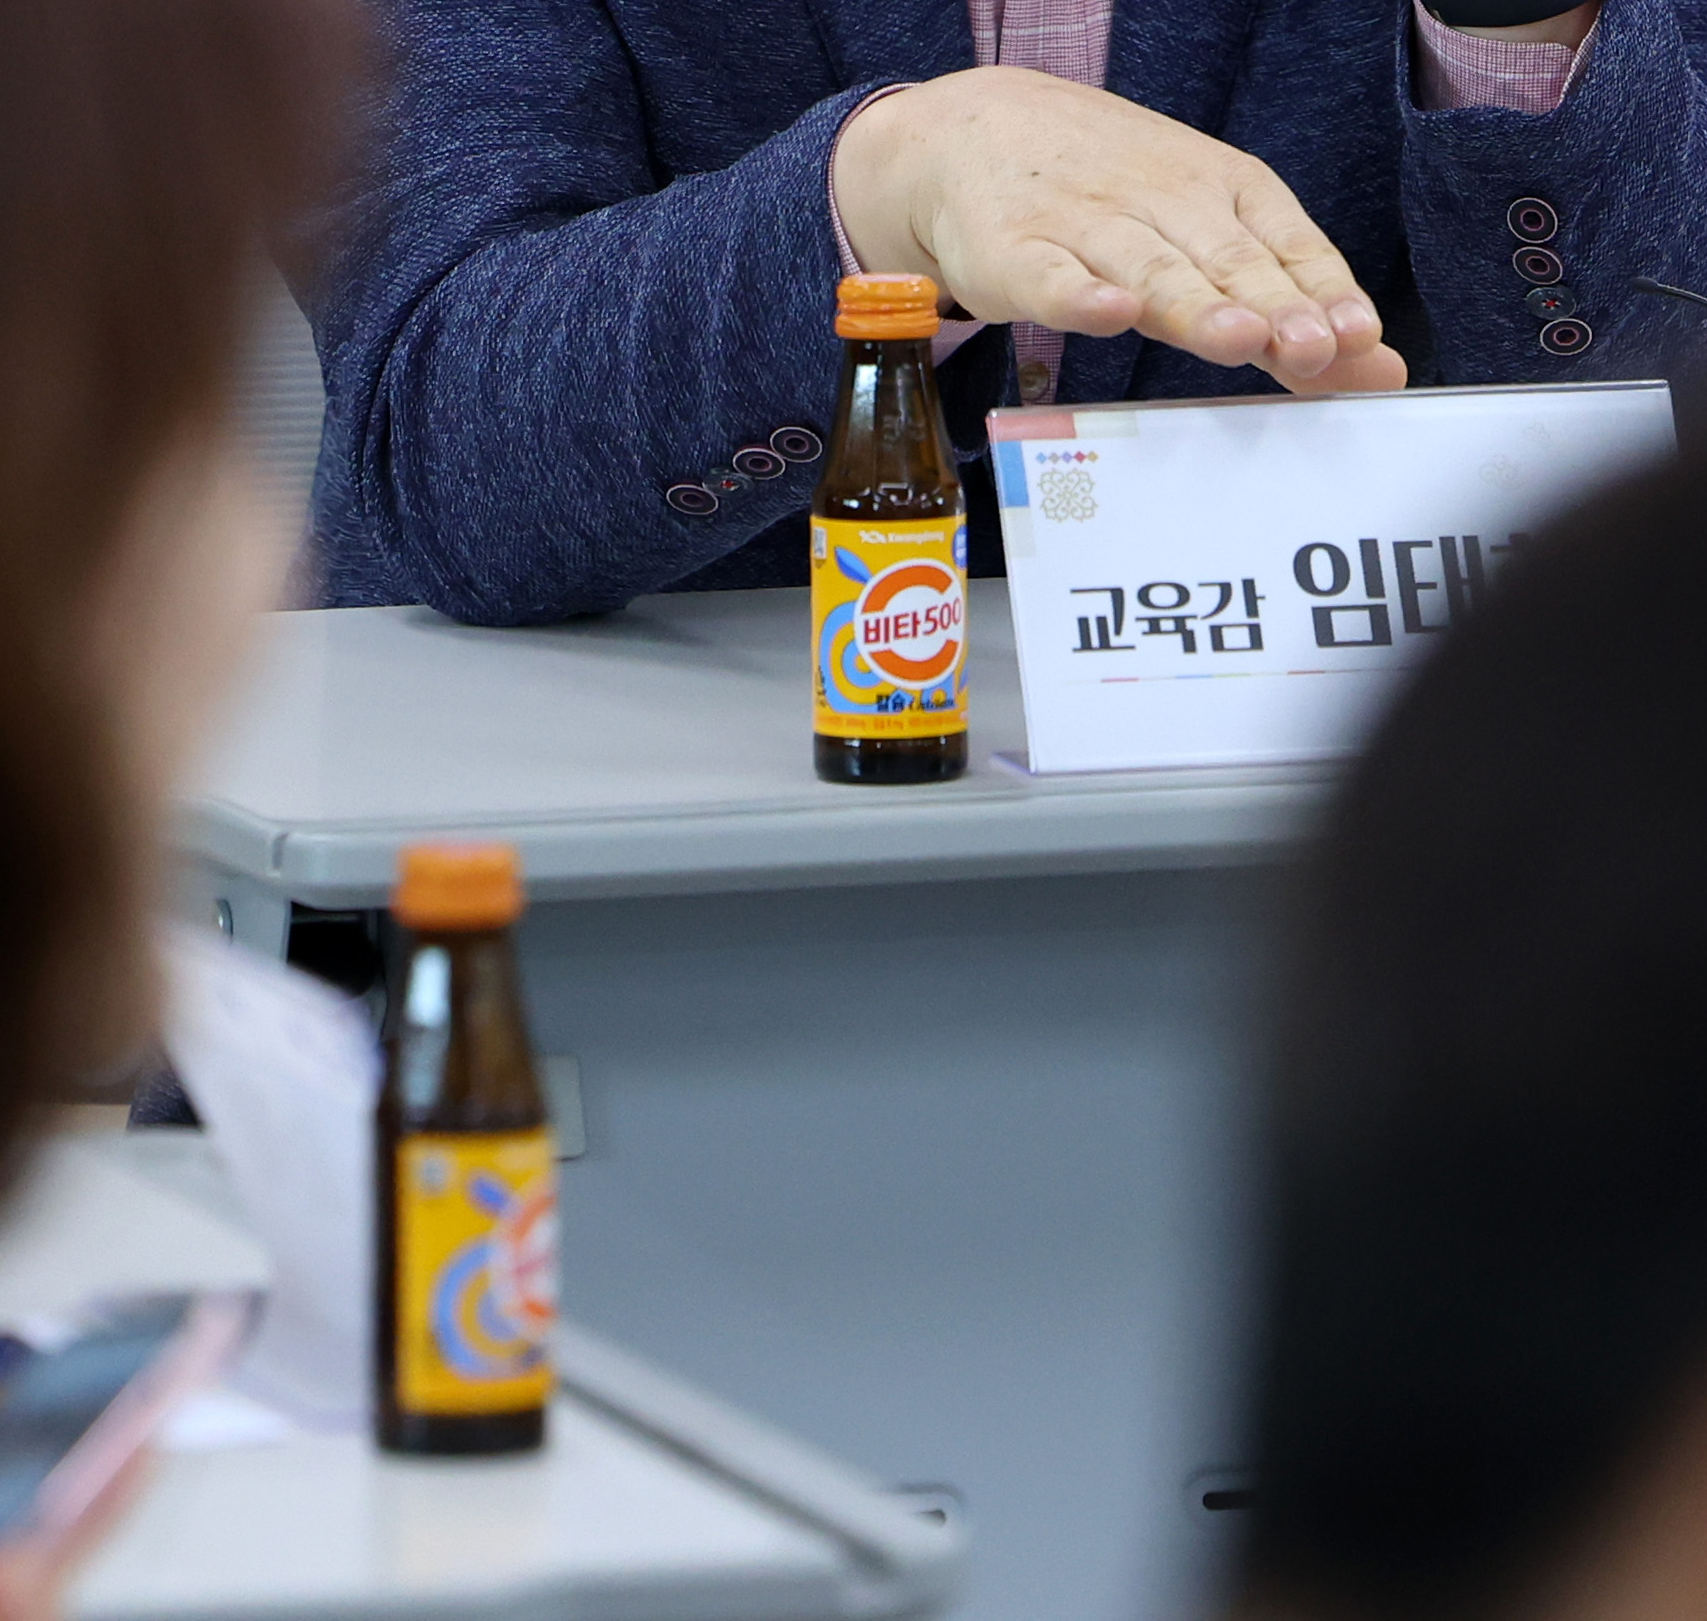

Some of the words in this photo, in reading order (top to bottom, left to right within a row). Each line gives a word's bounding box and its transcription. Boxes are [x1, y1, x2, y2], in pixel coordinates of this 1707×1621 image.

[863, 596, 962, 645] 비타500
[1069, 577, 1266, 654] 교육감
[1292, 533, 1533, 649] 임태
